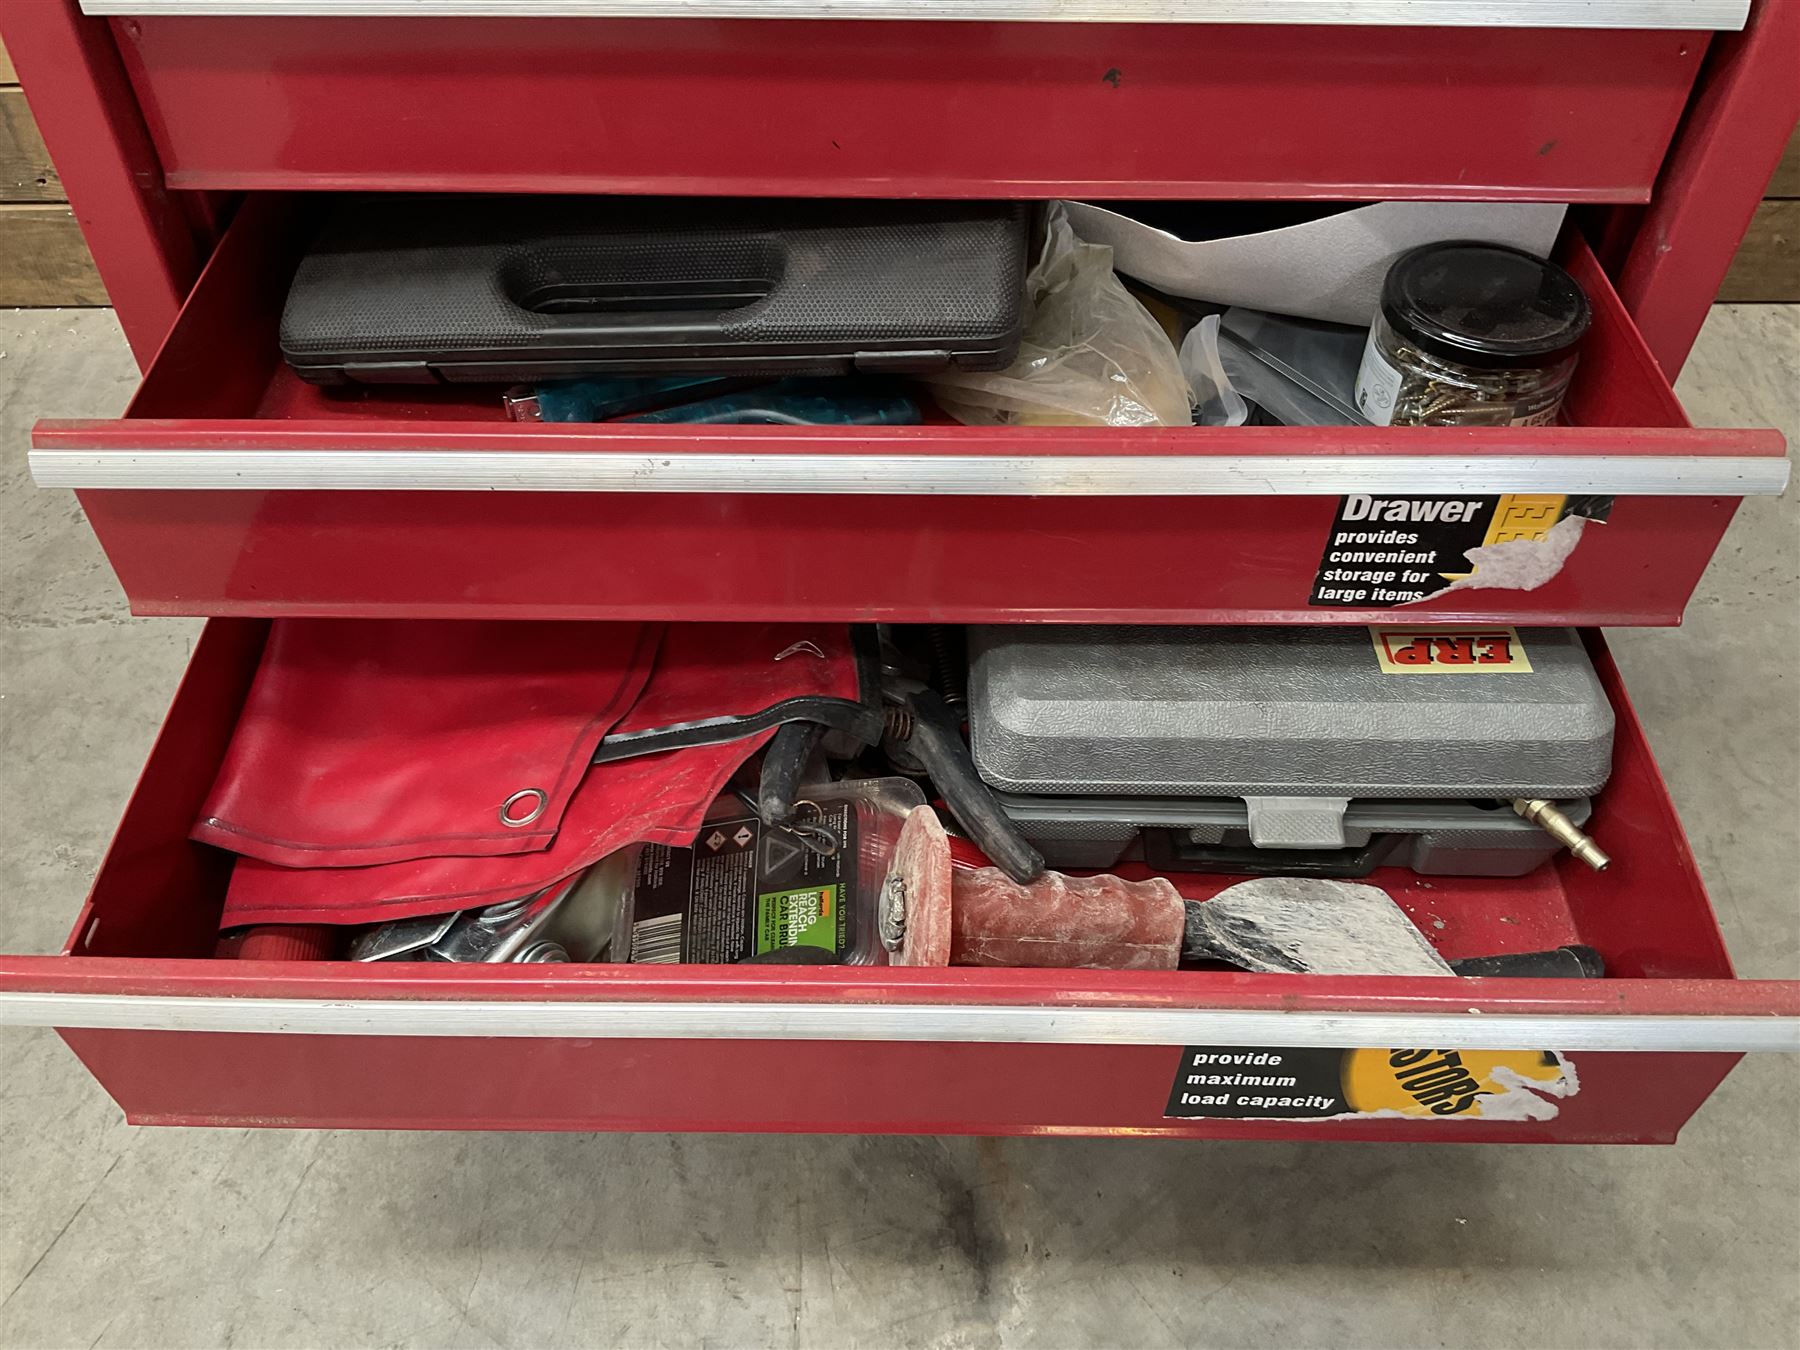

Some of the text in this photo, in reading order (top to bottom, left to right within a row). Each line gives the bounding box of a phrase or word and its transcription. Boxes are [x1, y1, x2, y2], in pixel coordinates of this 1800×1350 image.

[1342, 494, 1482, 523] Drawer
[1334, 530, 1418, 545] provides
[1330, 549, 1437, 564] convenient
[1323, 569, 1430, 583] storage for
[1317, 586, 1424, 602] large items
[1394, 637, 1513, 665] ERP
[798, 893, 808, 932] REACH
[807, 891, 817, 925] LONG
[779, 895, 788, 949] CAR BRU
[788, 894, 798, 947] EXTENDIN
[1192, 1052, 1282, 1067] provide
[1186, 1072, 1296, 1088] maximum
[1180, 1092, 1335, 1110] load capacity
